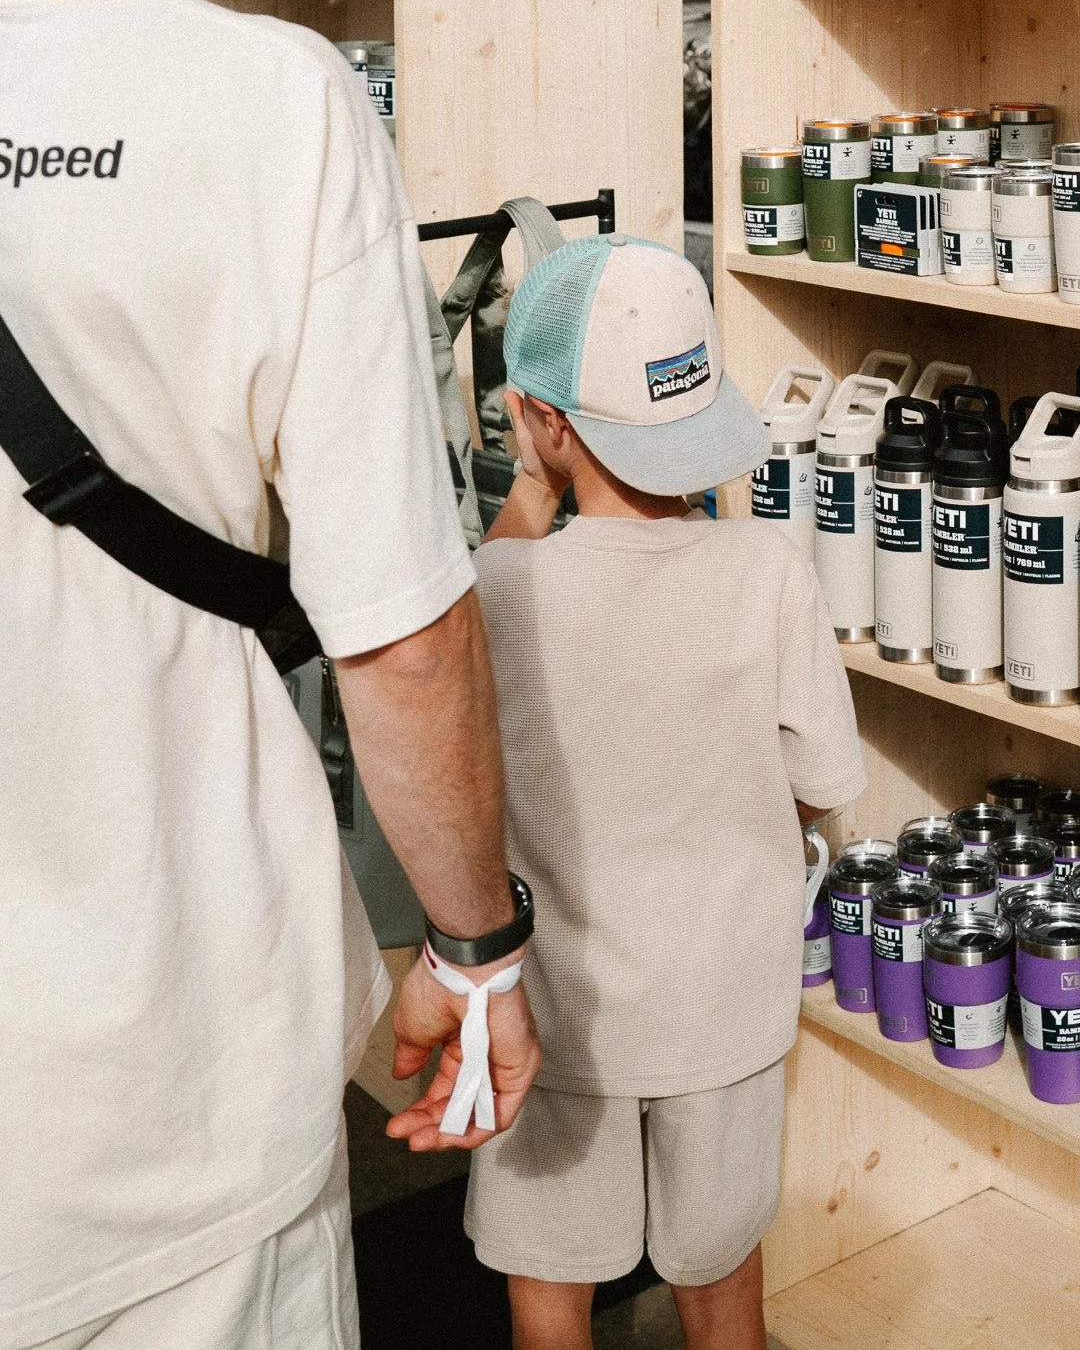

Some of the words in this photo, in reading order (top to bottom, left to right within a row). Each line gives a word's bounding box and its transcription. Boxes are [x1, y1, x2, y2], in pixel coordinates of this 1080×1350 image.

[0, 139, 123, 187] Speed
[877, 208, 896, 219] YETI
[653, 365, 708, 397] patagonia
[875, 492, 898, 511] ETI
[1008, 660, 1031, 677] YETI
[831, 897, 859, 915] YETI
[872, 921, 899, 941] YETI
